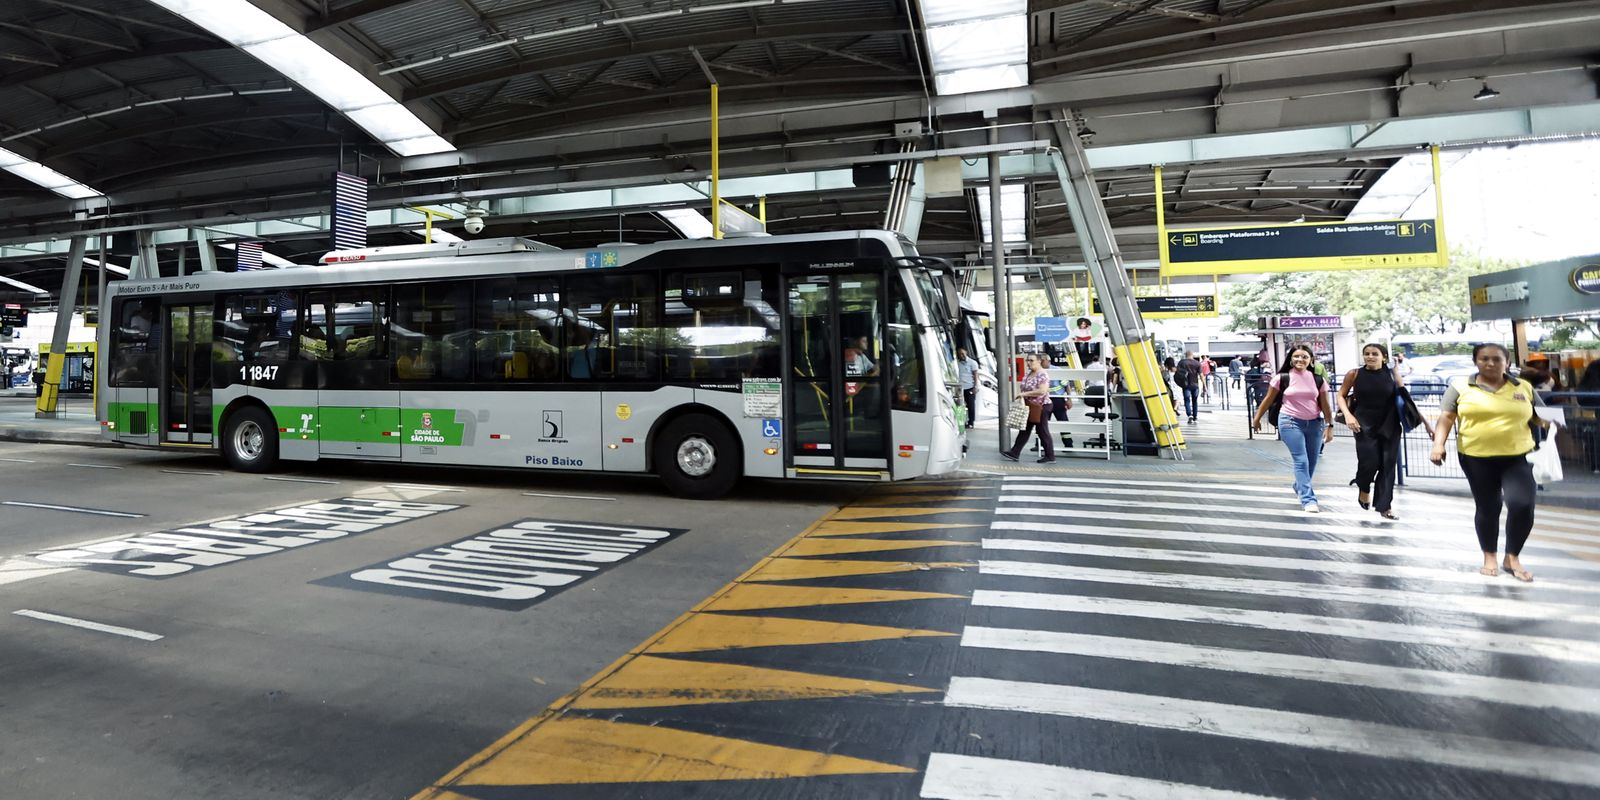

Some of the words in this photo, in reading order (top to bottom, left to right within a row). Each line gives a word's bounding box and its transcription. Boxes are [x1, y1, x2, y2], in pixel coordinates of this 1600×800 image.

[119, 286, 136, 294] Motor
[137, 285, 151, 293] Euro
[185, 282, 200, 290] Puro
[240, 365, 246, 380] 1
[249, 365, 279, 380] 1847
[410, 434, 423, 442] SÃO
[424, 435, 445, 443] PAULO
[525, 455, 548, 465] Piso
[552, 456, 583, 467] Baixo
[35, 497, 461, 576] PEDESTRES
[350, 521, 671, 600] CUIDADO
